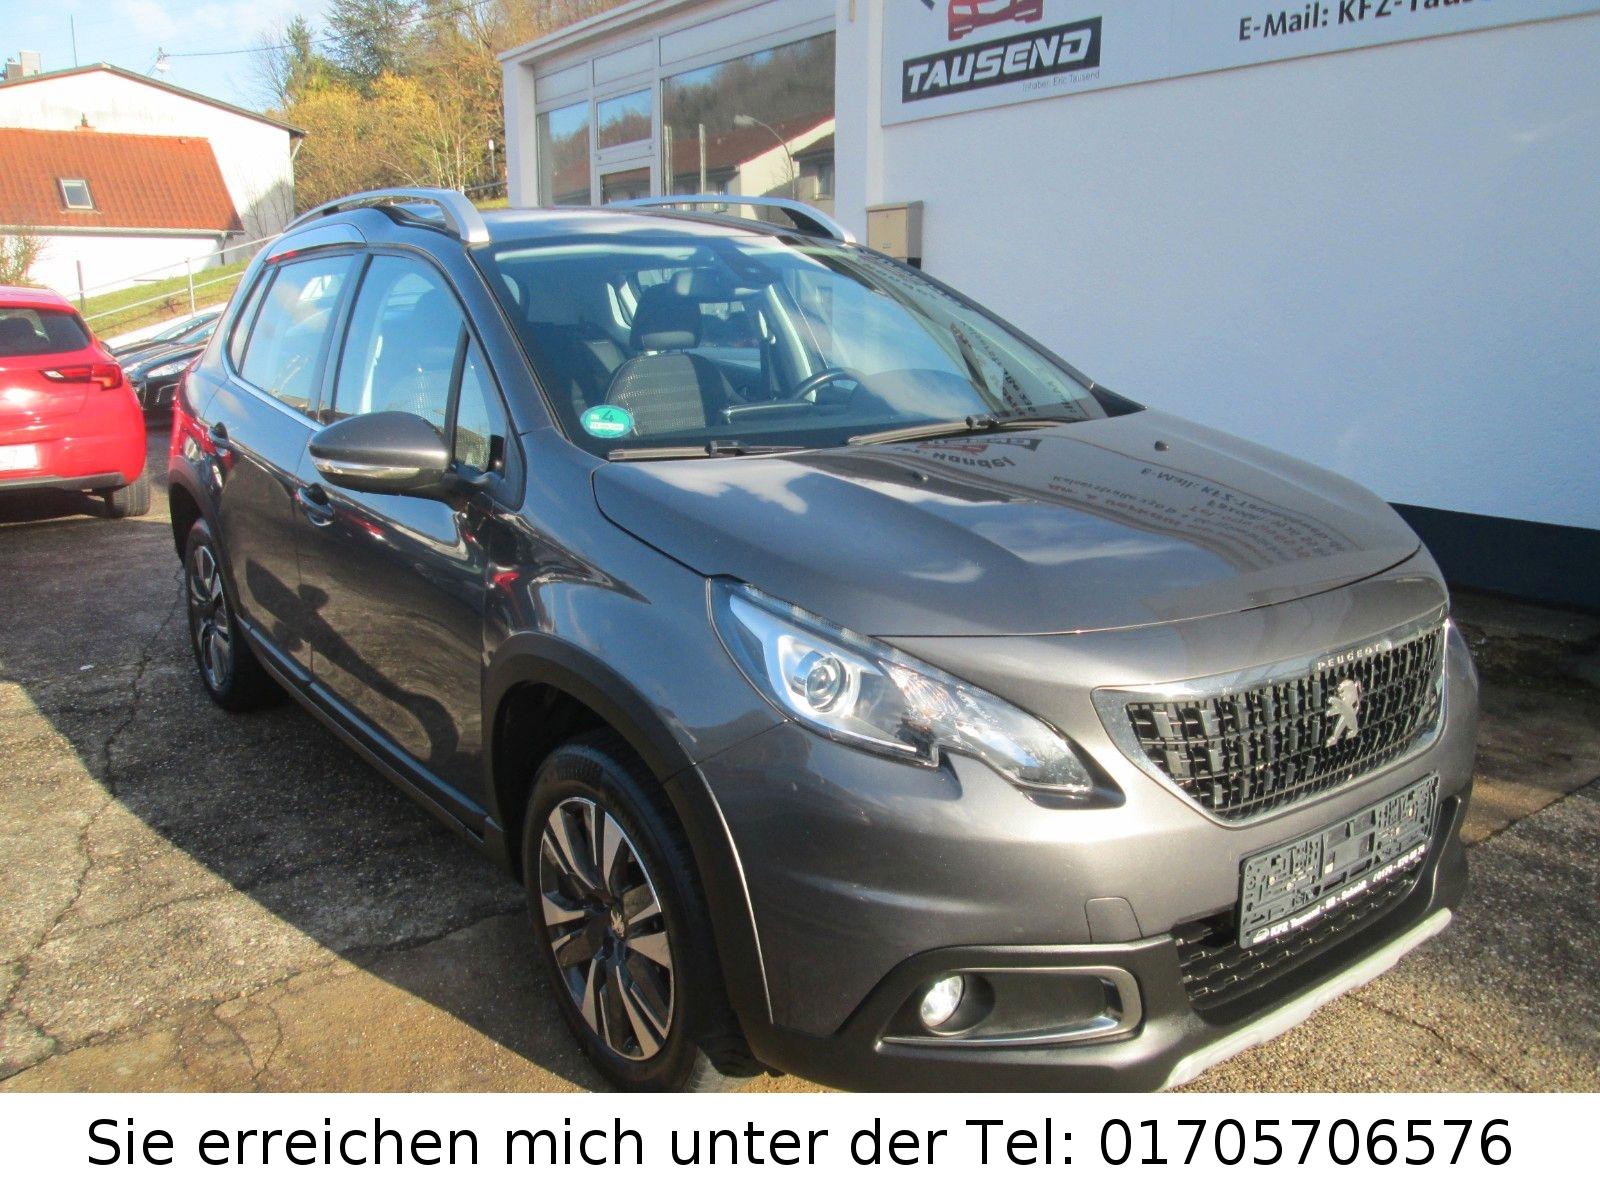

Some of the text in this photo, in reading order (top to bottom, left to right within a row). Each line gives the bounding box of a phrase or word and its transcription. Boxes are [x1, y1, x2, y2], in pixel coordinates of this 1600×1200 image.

[1238, 1, 1329, 41] E-Mail:
[907, 28, 1092, 94] TAUSEND
[601, 410, 615, 422] 4
[1317, 643, 1381, 671] PEUGEOT
